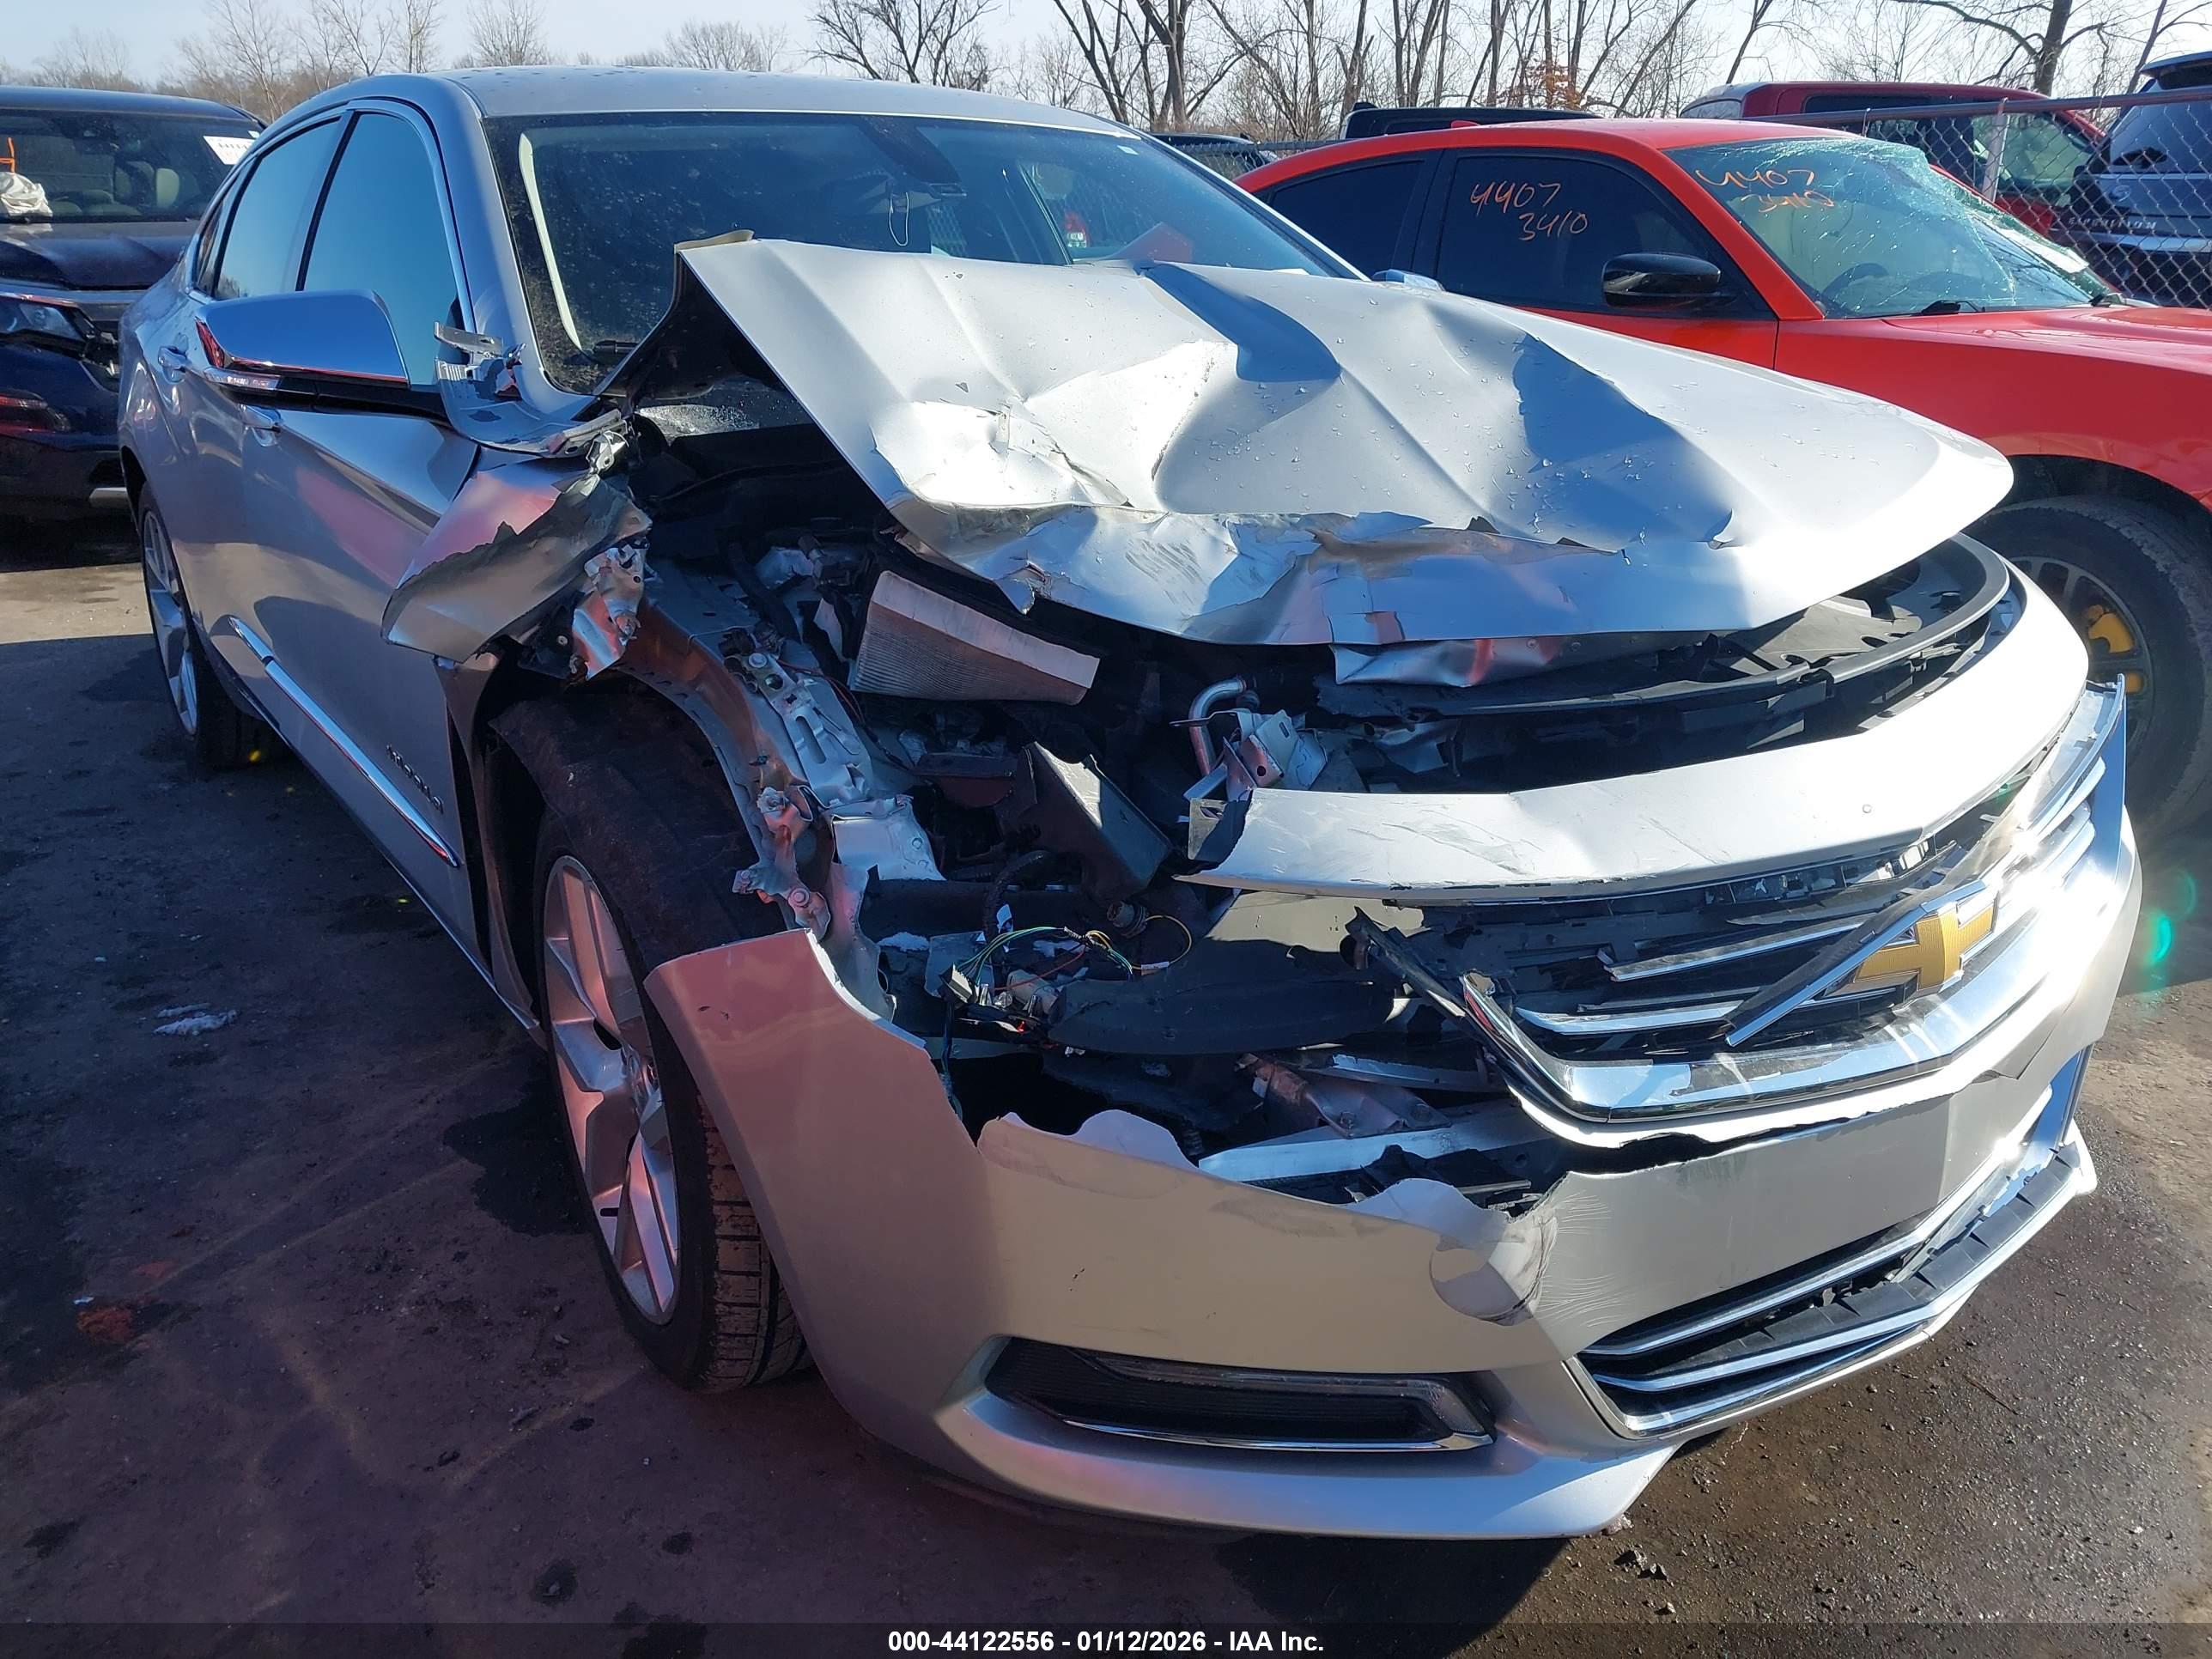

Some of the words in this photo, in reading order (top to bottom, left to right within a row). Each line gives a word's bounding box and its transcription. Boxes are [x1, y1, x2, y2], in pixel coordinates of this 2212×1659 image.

[1695, 169, 1815, 189] 4407
[1469, 180, 1562, 216] 4407
[1518, 210, 1589, 241] 3410
